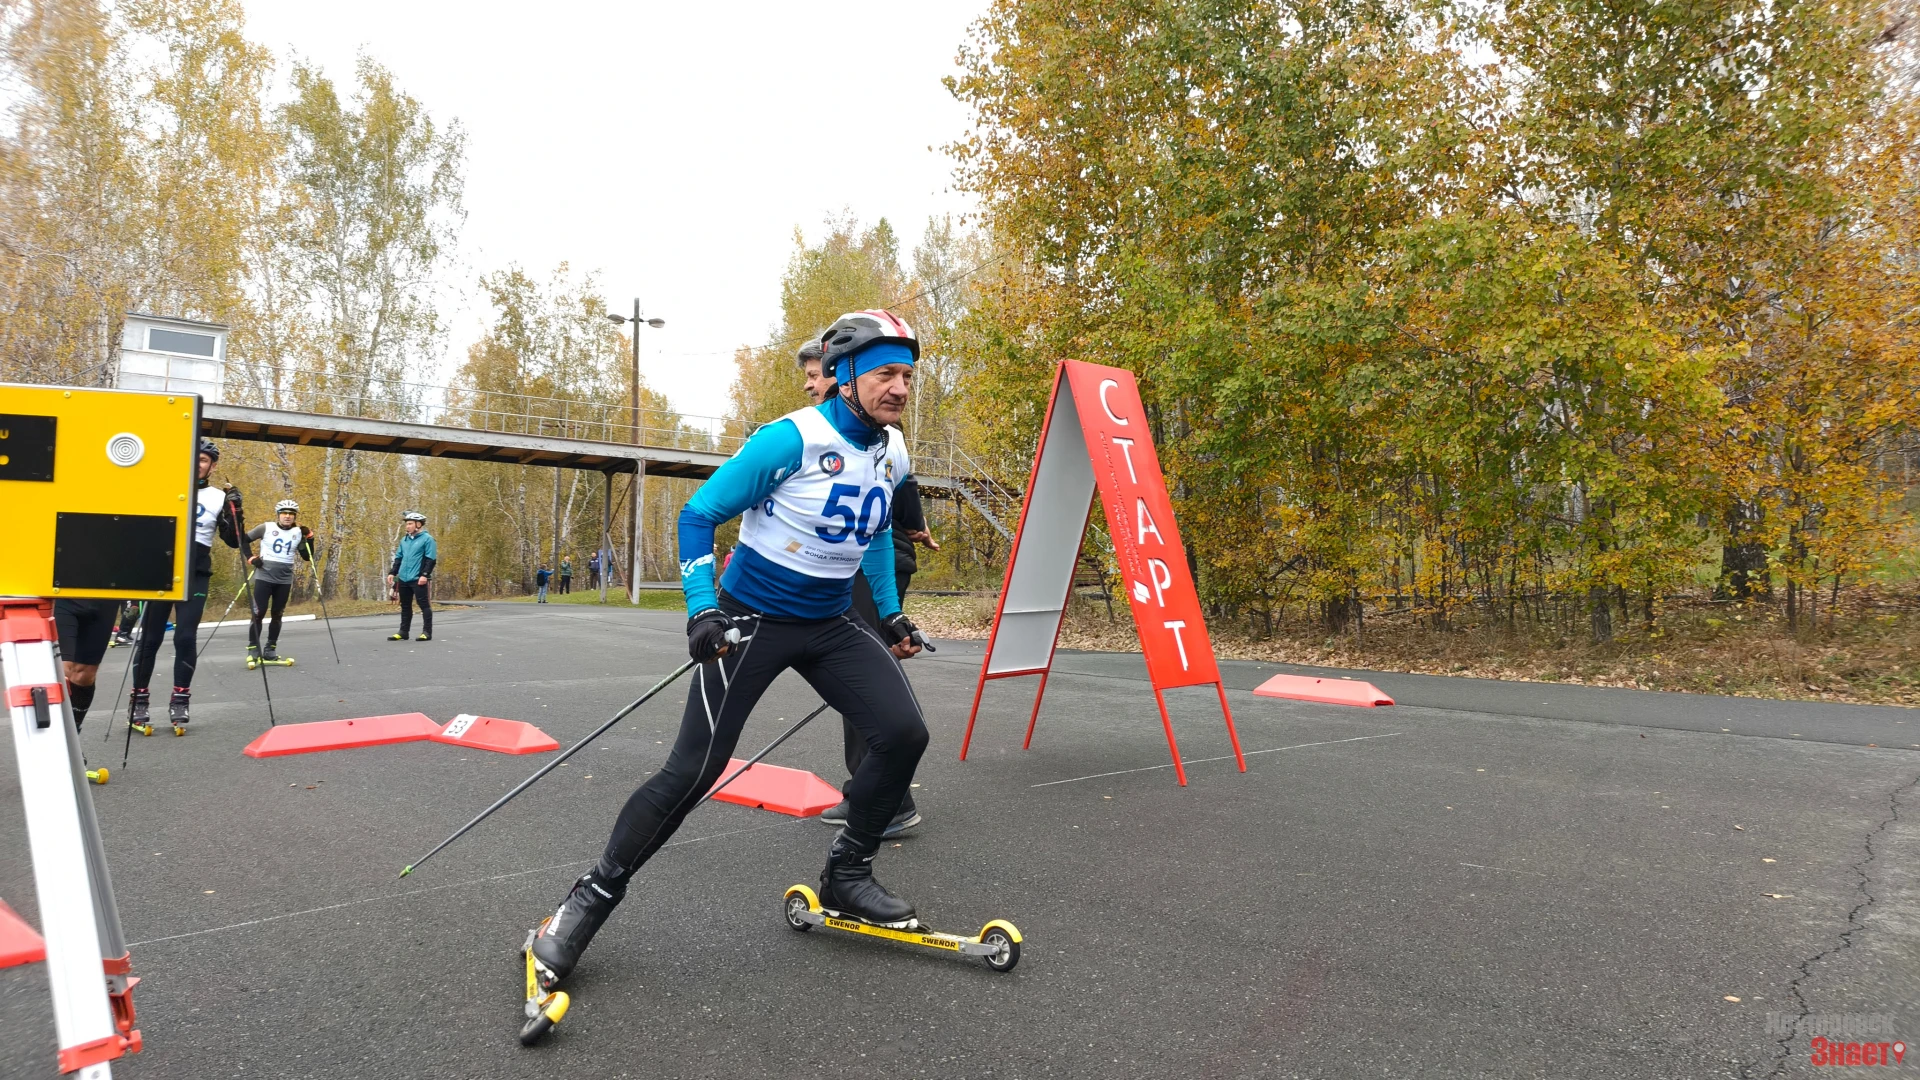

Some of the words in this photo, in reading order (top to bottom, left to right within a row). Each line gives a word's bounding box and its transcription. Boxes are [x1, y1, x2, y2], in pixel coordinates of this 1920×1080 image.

[815, 482, 887, 547] 50
[1099, 378, 1188, 672] СТАРТ
[272, 538, 293, 556] 61
[804, 550, 828, 560] ФОНДА
[828, 919, 861, 931] SWENOR
[921, 936, 957, 949] SWENOR
